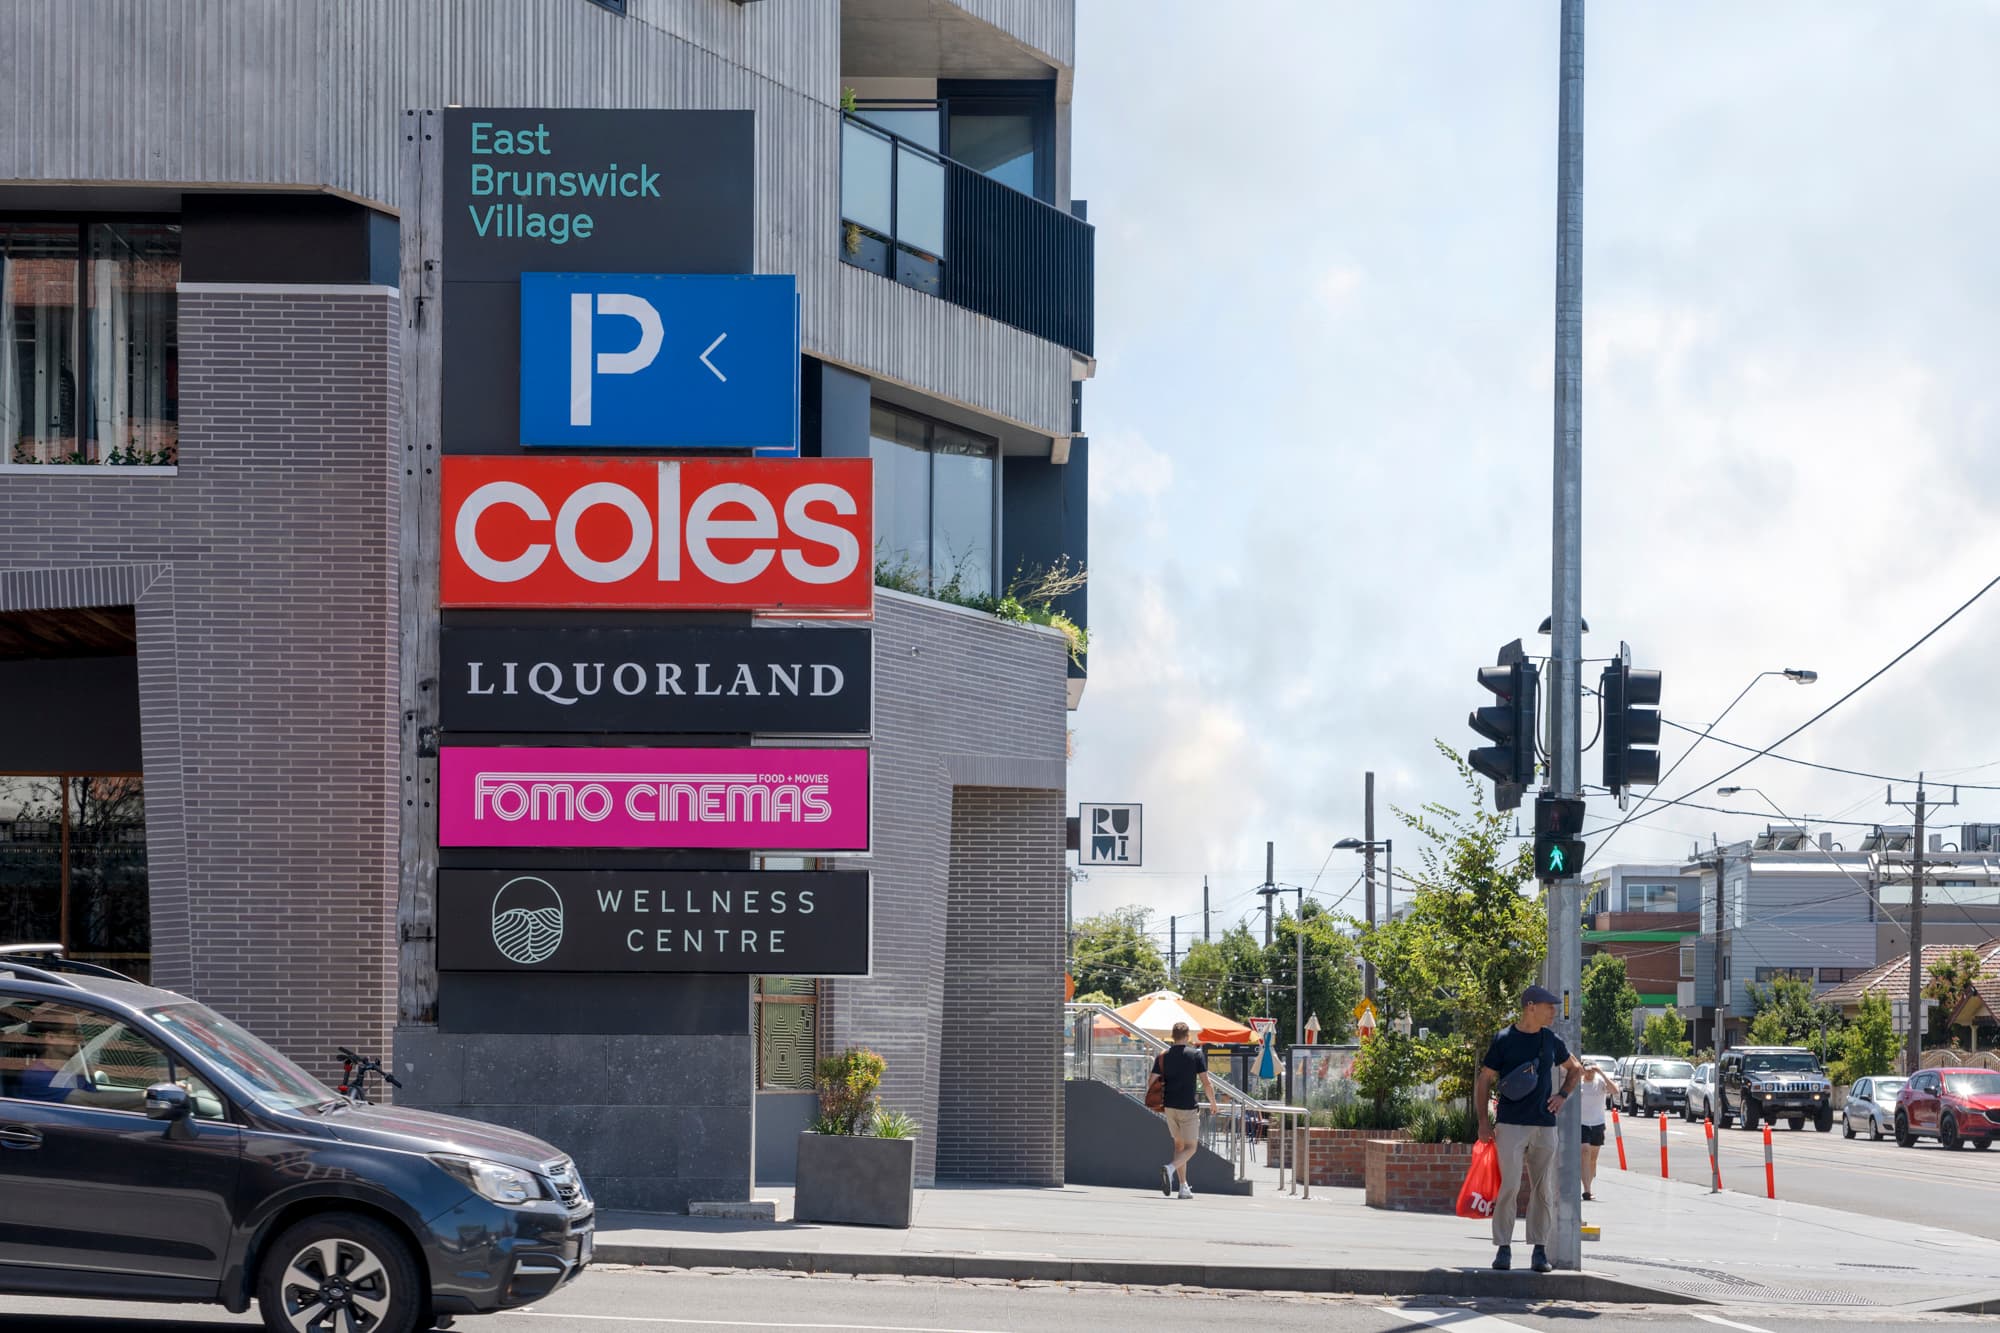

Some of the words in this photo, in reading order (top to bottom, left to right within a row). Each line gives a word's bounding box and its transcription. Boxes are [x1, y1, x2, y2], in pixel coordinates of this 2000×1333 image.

[472, 122, 551, 155] East
[471, 163, 660, 197] Brunswick
[469, 204, 594, 245] Village
[570, 293, 665, 426] P
[454, 461, 860, 584] coles
[467, 662, 845, 704] LIQUORLAND
[758, 773, 785, 784] FOOD
[794, 773, 829, 784] MOVIES
[474, 772, 613, 822] FOMO
[625, 783, 832, 823] CINEMAS
[597, 889, 816, 914] WELLNESS
[627, 929, 785, 953] CENTRE
